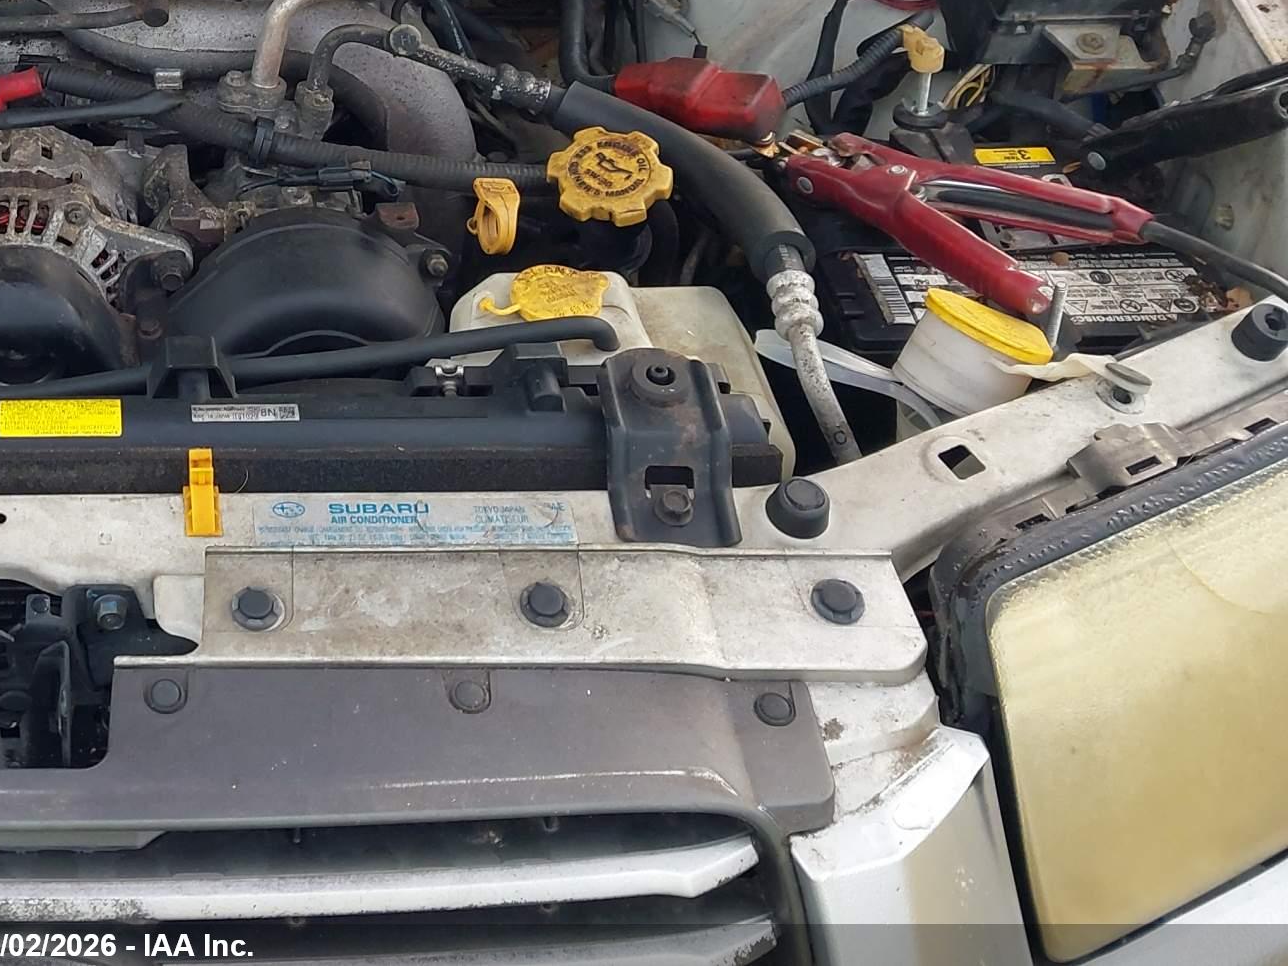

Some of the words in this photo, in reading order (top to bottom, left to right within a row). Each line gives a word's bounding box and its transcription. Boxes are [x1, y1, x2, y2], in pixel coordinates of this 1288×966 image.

[575, 145, 593, 159] SEE
[596, 140, 640, 158] ENGINE
[1016, 149, 1032, 161] 3
[636, 157, 649, 173] OIL
[605, 177, 647, 197] MANUAL
[328, 502, 430, 515] SUBARU
[330, 515, 347, 524] AIR
[349, 515, 417, 524] CONDITIONER
